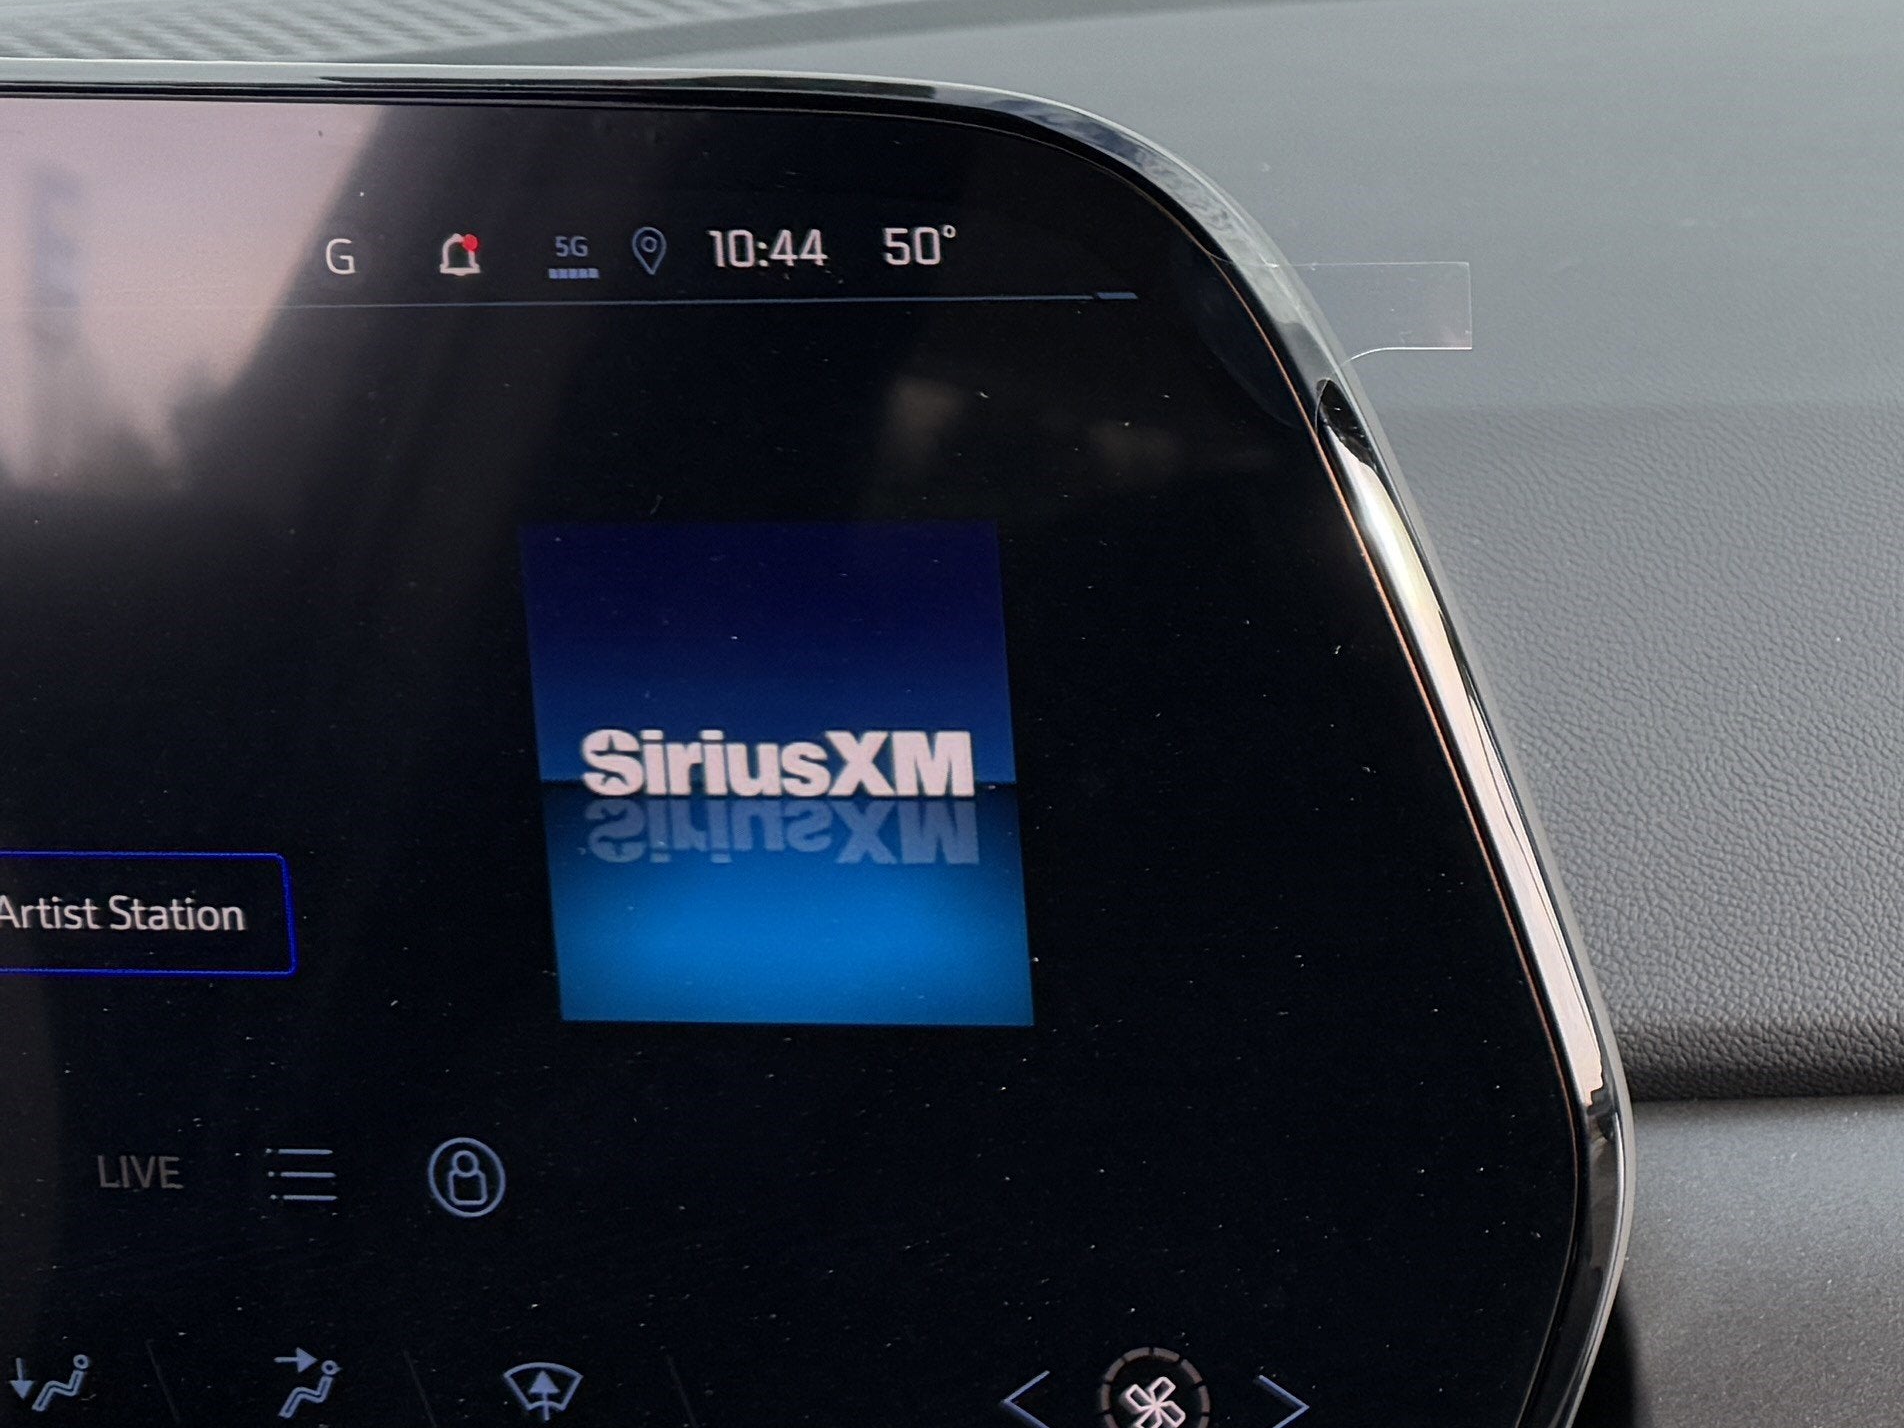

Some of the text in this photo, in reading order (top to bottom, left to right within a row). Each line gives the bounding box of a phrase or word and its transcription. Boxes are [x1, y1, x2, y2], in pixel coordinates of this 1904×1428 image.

[326, 237, 357, 276] G
[555, 234, 589, 260] 5G
[707, 224, 957, 269] 10:44 50°
[580, 728, 977, 798] SiriusXM
[0, 895, 246, 931] Artist Station
[97, 1153, 185, 1189] LIVE
